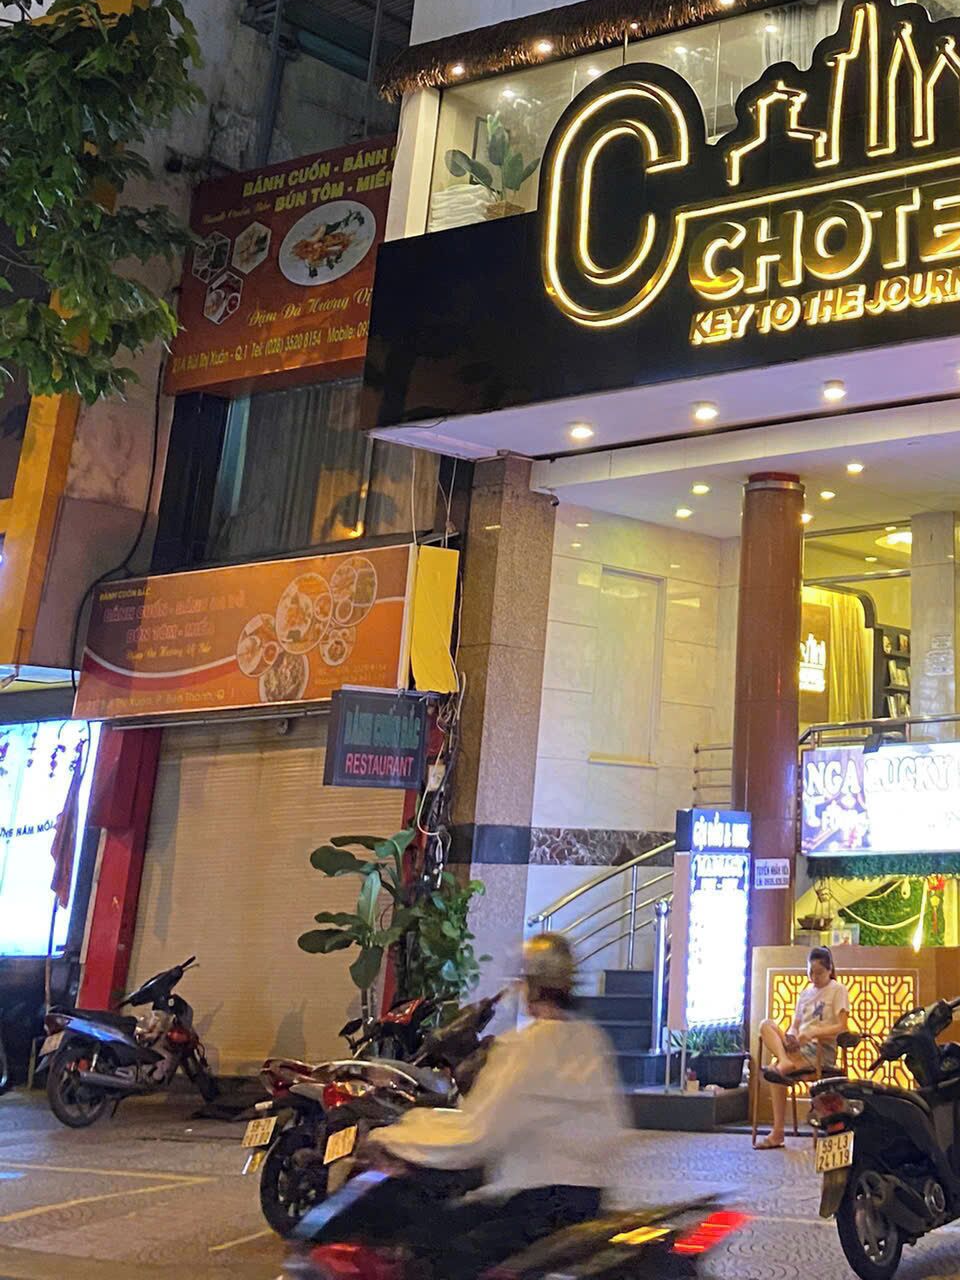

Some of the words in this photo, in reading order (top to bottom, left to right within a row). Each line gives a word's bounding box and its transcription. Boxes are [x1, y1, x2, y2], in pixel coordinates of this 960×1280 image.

[243, 175, 286, 197] BÁNH
[342, 148, 388, 173] BÁNH
[274, 187, 308, 212] BÚN
[311, 181, 344, 204] TÔM
[689, 304, 754, 346] KEY
[754, 295, 802, 333] TO
[801, 283, 867, 328] THE
[345, 753, 414, 776] RESTAURANT
